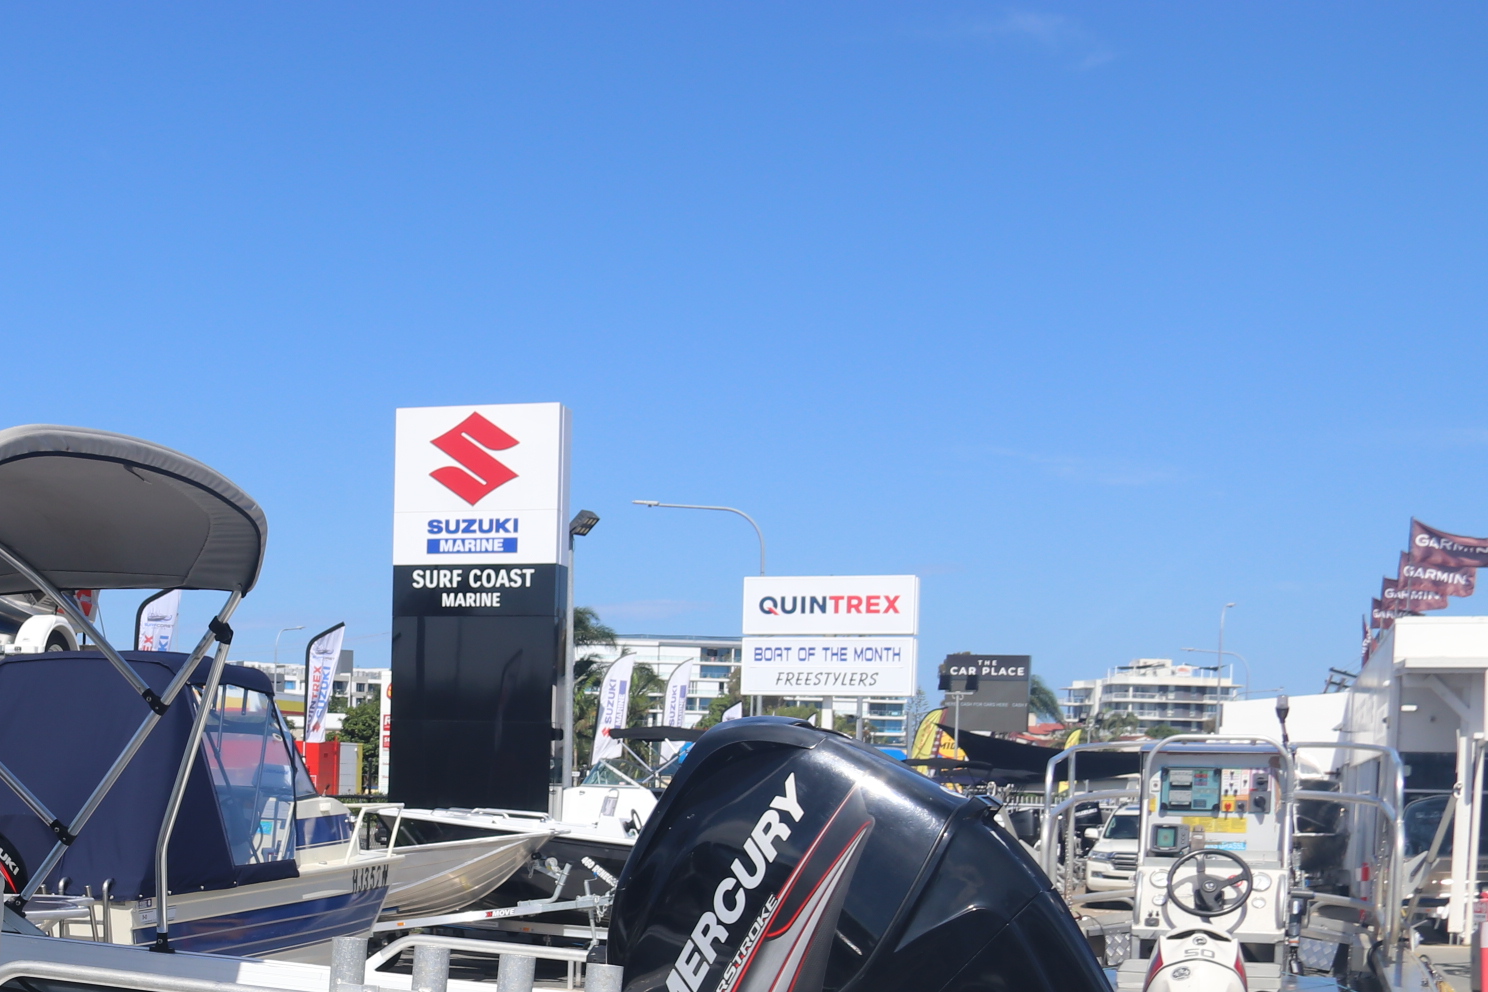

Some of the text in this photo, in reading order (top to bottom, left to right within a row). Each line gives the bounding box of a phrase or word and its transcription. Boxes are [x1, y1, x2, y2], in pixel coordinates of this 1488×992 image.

[427, 518, 518, 534] SUZUKI
[440, 539, 504, 552] MARINE
[412, 569, 535, 588] SURF COAST
[1403, 565, 1467, 585] GARMIN
[442, 593, 501, 607] MARINE
[759, 595, 901, 616] QUINTREX
[754, 647, 901, 662] BOAT OF THE MONTH
[775, 671, 879, 687] FREESTYLERS
[950, 667, 1025, 676] CAR PLACE
[317, 666, 331, 718] SUZUKI
[605, 679, 617, 724] SUZUKI
[493, 909, 515, 917] MOVE
